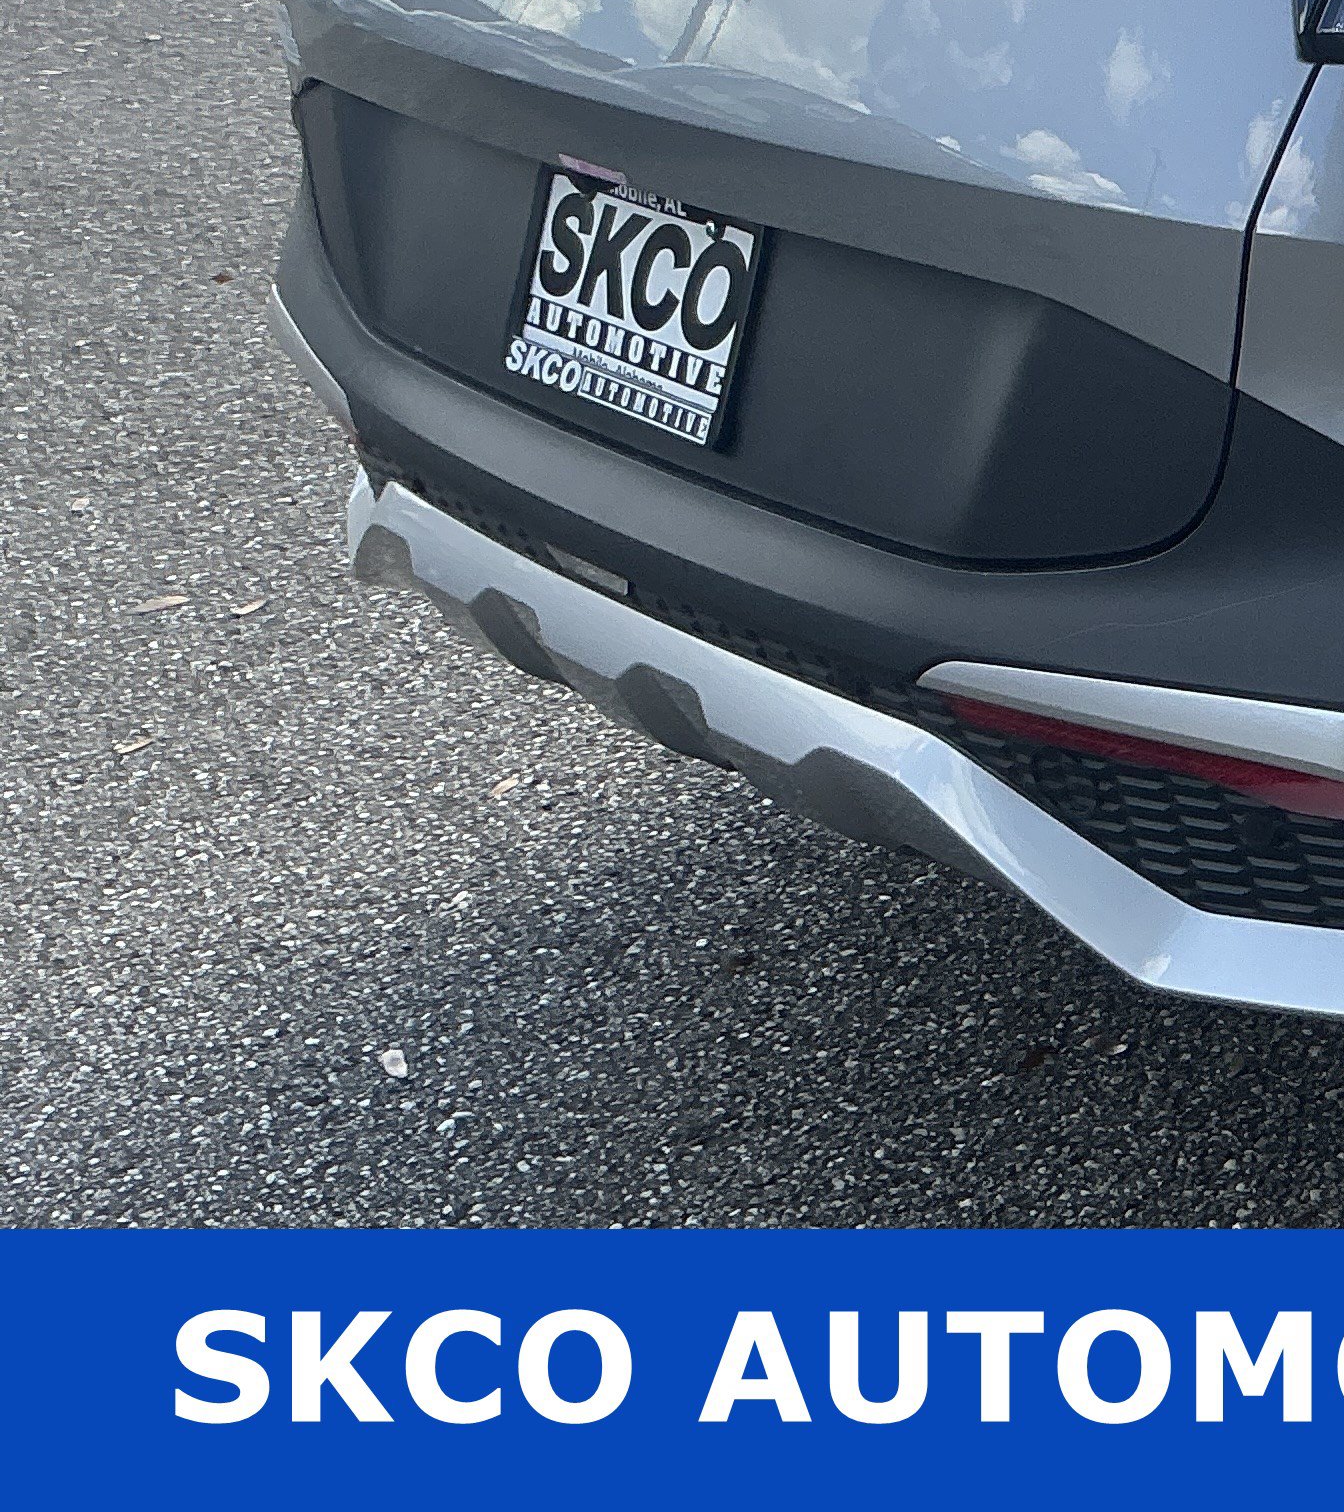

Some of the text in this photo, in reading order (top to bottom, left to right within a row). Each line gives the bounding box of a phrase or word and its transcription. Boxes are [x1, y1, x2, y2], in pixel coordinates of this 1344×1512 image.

[609, 185, 662, 212] obile,
[539, 192, 750, 350] SKCO
[505, 339, 710, 439] SKCO AUTOMOTIVE
[526, 296, 727, 395] AUTOMOTIVE
